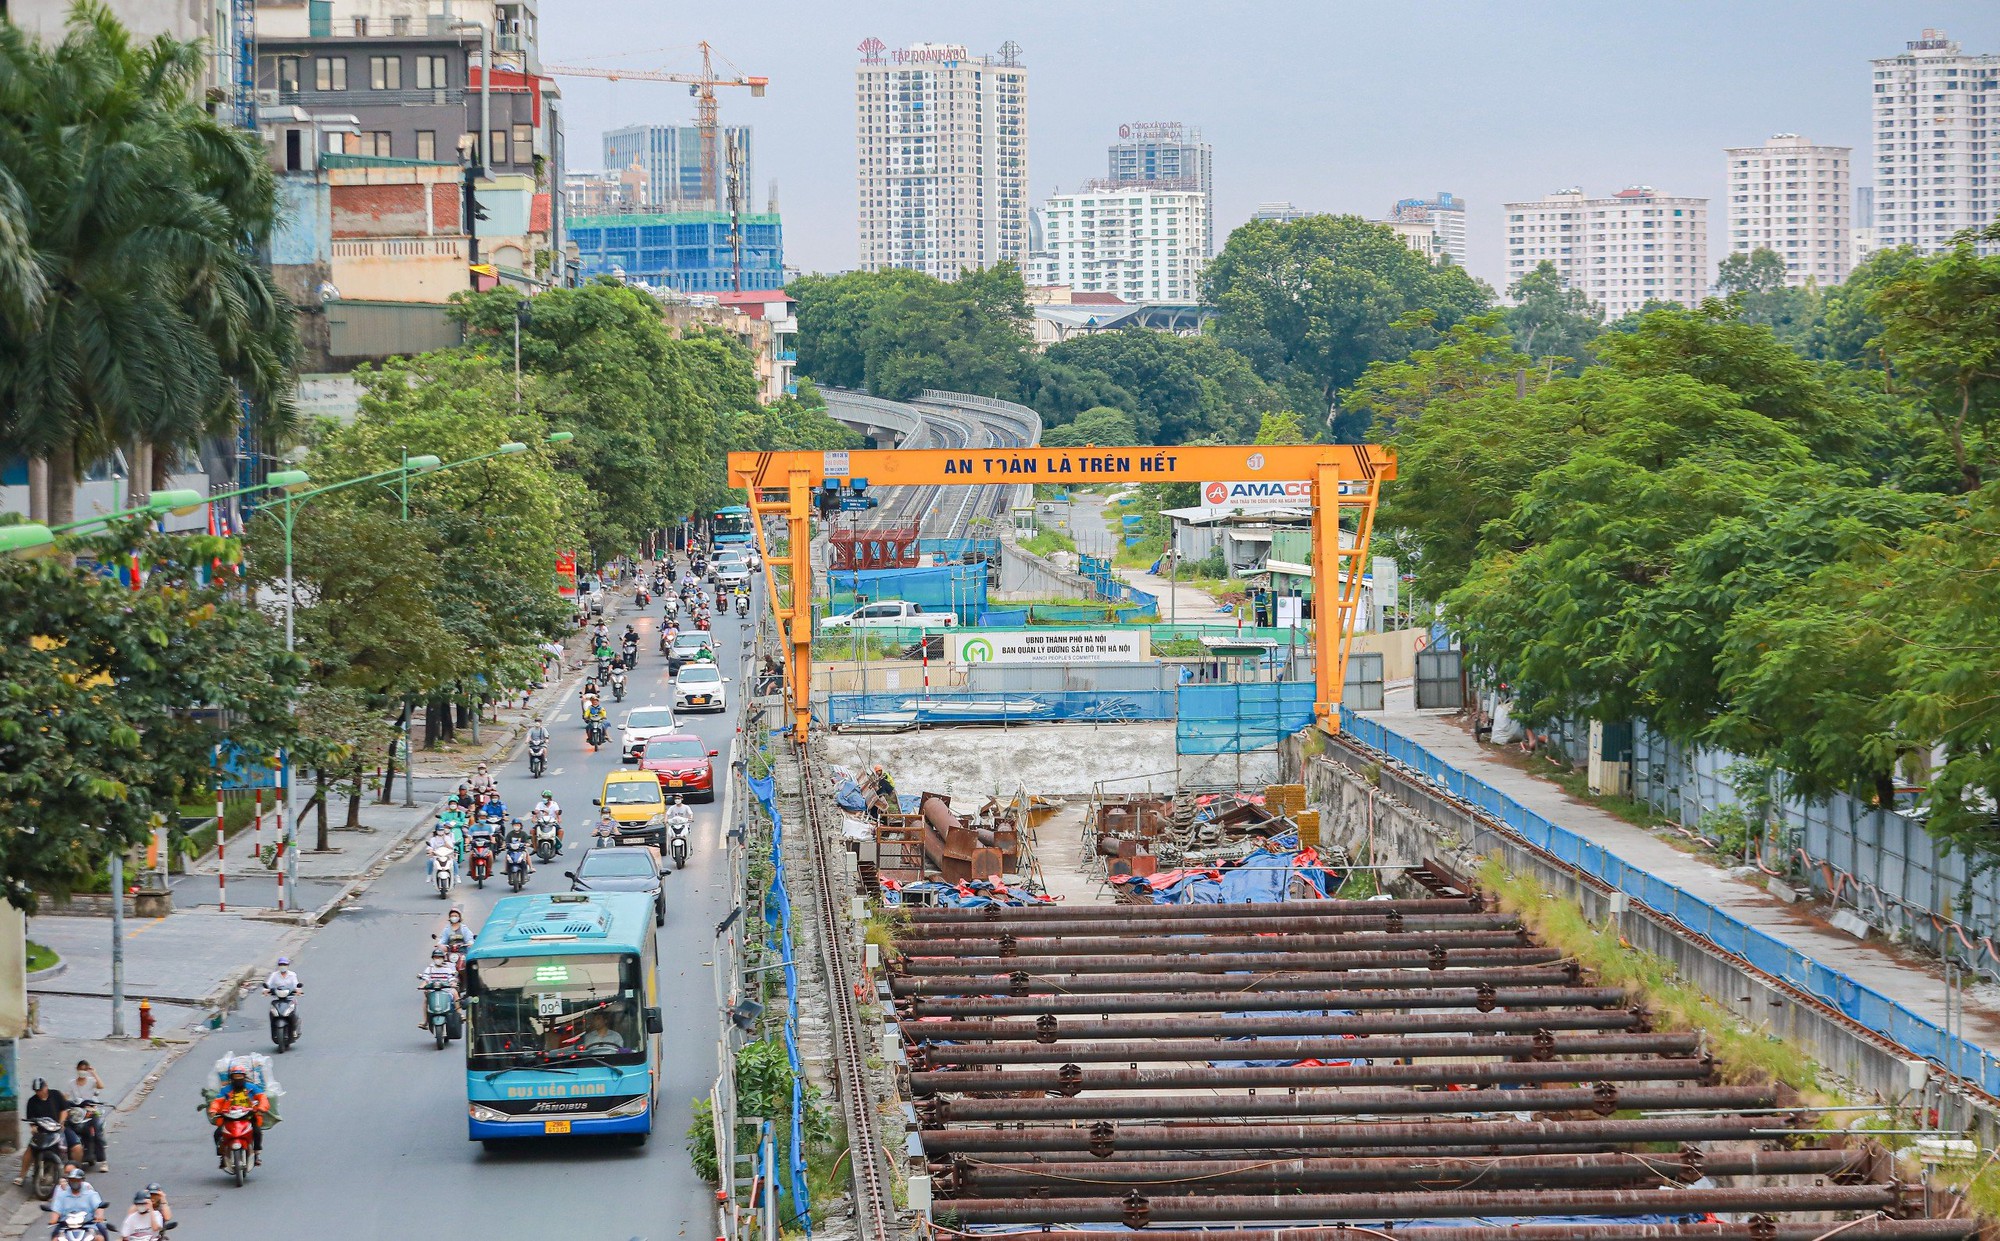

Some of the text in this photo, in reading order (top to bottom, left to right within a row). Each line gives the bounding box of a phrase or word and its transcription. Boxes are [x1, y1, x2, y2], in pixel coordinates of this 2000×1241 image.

[944, 458, 973, 474] AN
[1047, 452, 1072, 473] LÀ
[1078, 453, 1130, 472] TRÊN
[1140, 450, 1177, 472] HẾT
[1248, 455, 1263, 468] 5T
[1025, 633, 1107, 644] UBND THÀNH PHỐ HÀ NỘI
[1001, 643, 1131, 654] BAN QUẢN LÝ ĐƯỜNG SẮT ĐÔ THỊ HÀ NỘI
[507, 1083, 606, 1098] BUS LIÊN NINH
